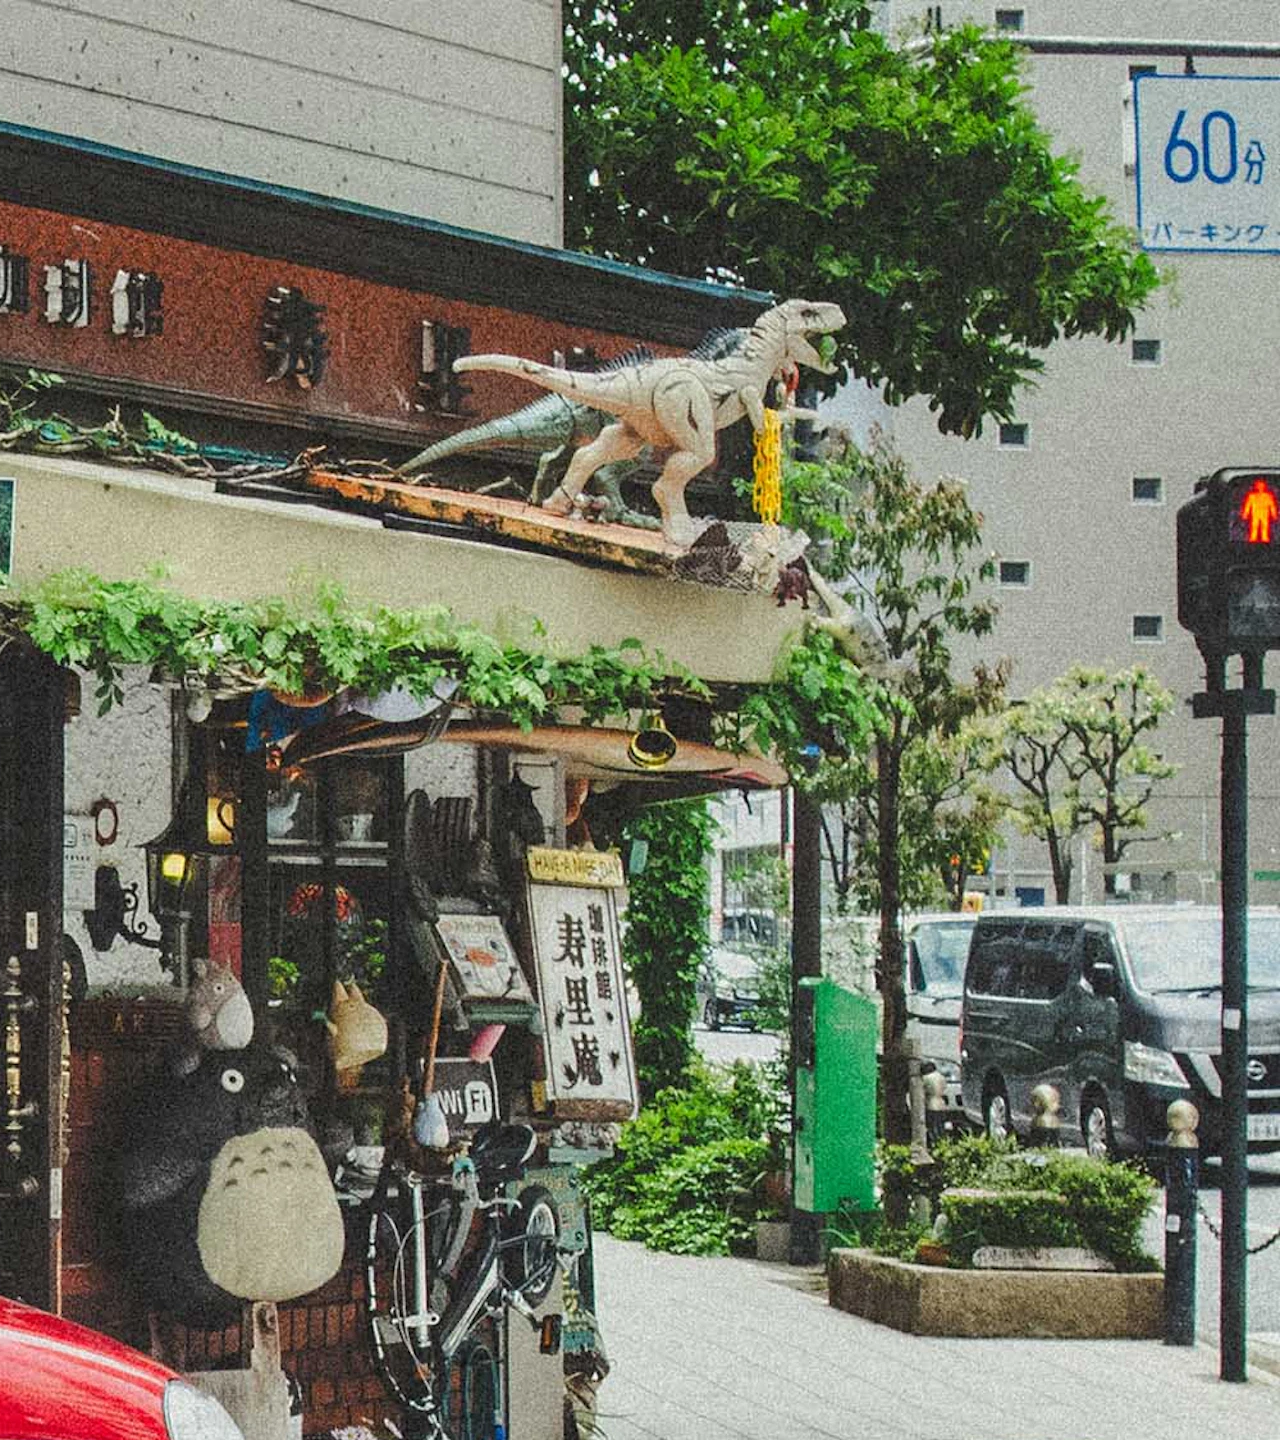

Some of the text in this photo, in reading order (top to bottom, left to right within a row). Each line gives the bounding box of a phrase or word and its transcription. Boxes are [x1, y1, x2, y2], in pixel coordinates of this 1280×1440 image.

[1164, 109, 1266, 184] 60分
[552, 912, 603, 1090] 寿里庵
